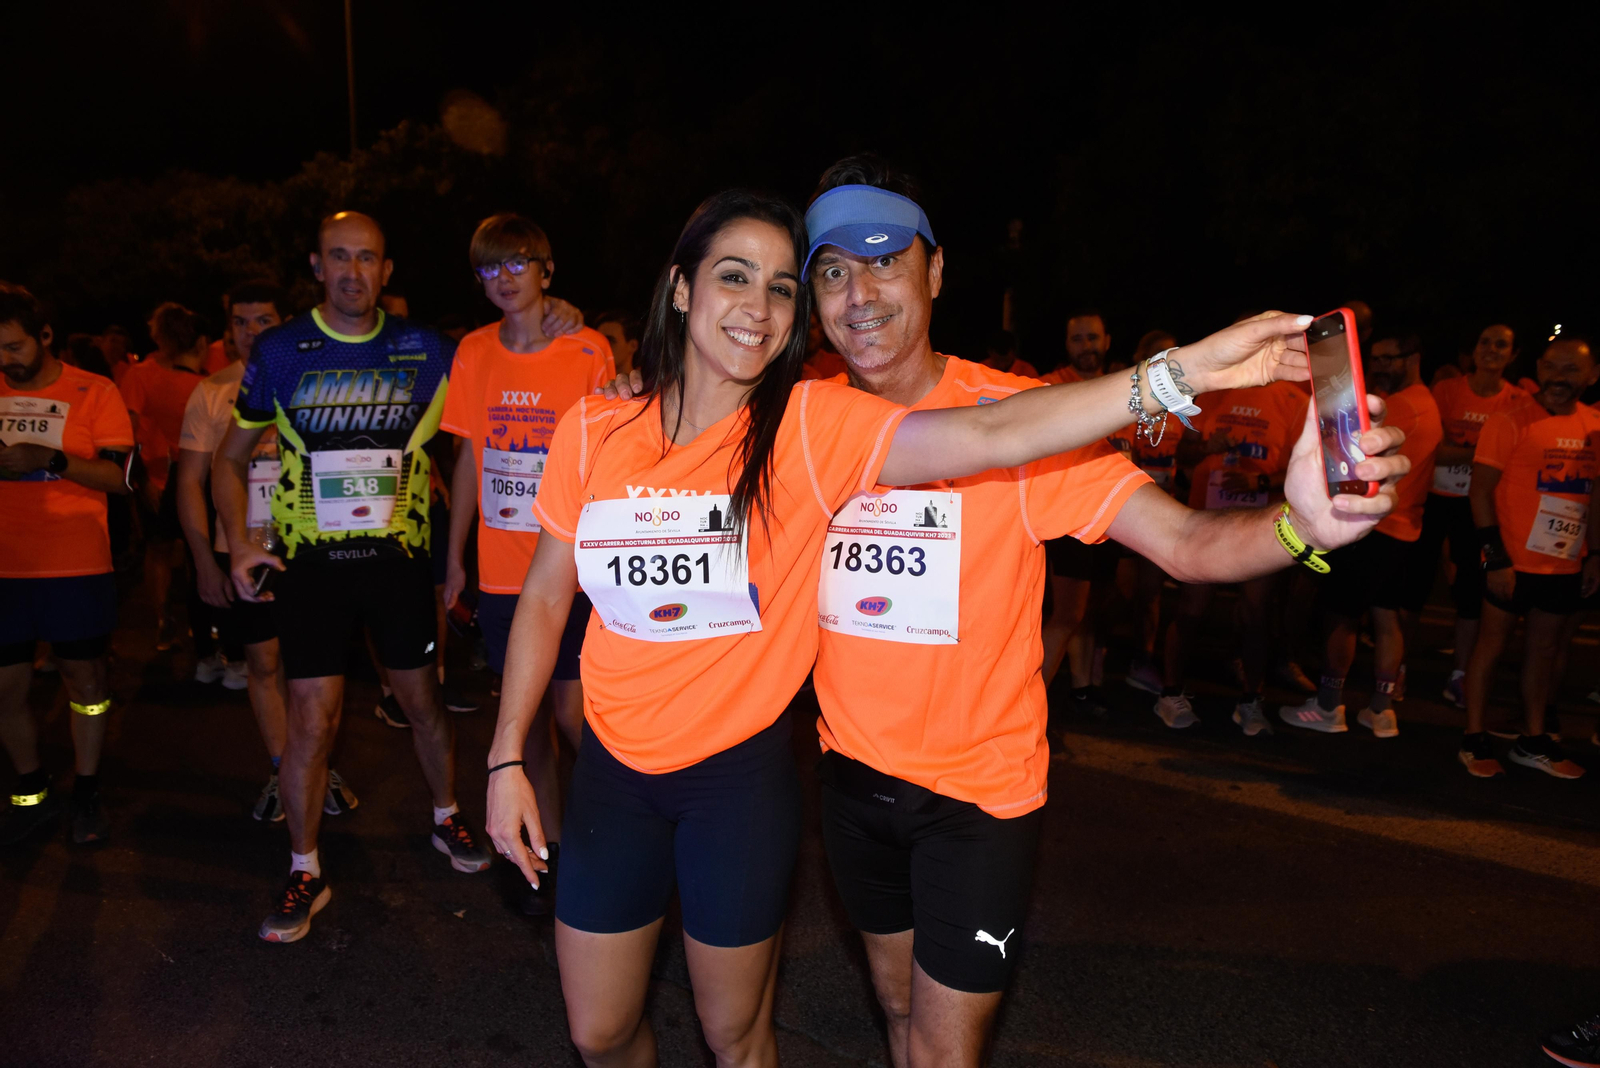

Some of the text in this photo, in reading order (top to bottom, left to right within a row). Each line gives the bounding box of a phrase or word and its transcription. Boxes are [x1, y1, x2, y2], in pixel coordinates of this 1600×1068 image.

[290, 368, 418, 409] AMATE
[501, 390, 542, 406] XXXV
[294, 404, 420, 433] RUNNERS
[492, 414, 556, 424] GUADALQUIVIR
[1230, 405, 1262, 418] XXXV
[342, 477, 379, 496] 548
[491, 477, 538, 498] 10694
[328, 548, 378, 560] SEVILLA
[830, 541, 926, 576] 18363
[607, 552, 710, 586] 18361
[708, 619, 751, 628] Cruzcampo
[906, 626, 949, 636] Cruzcampo
